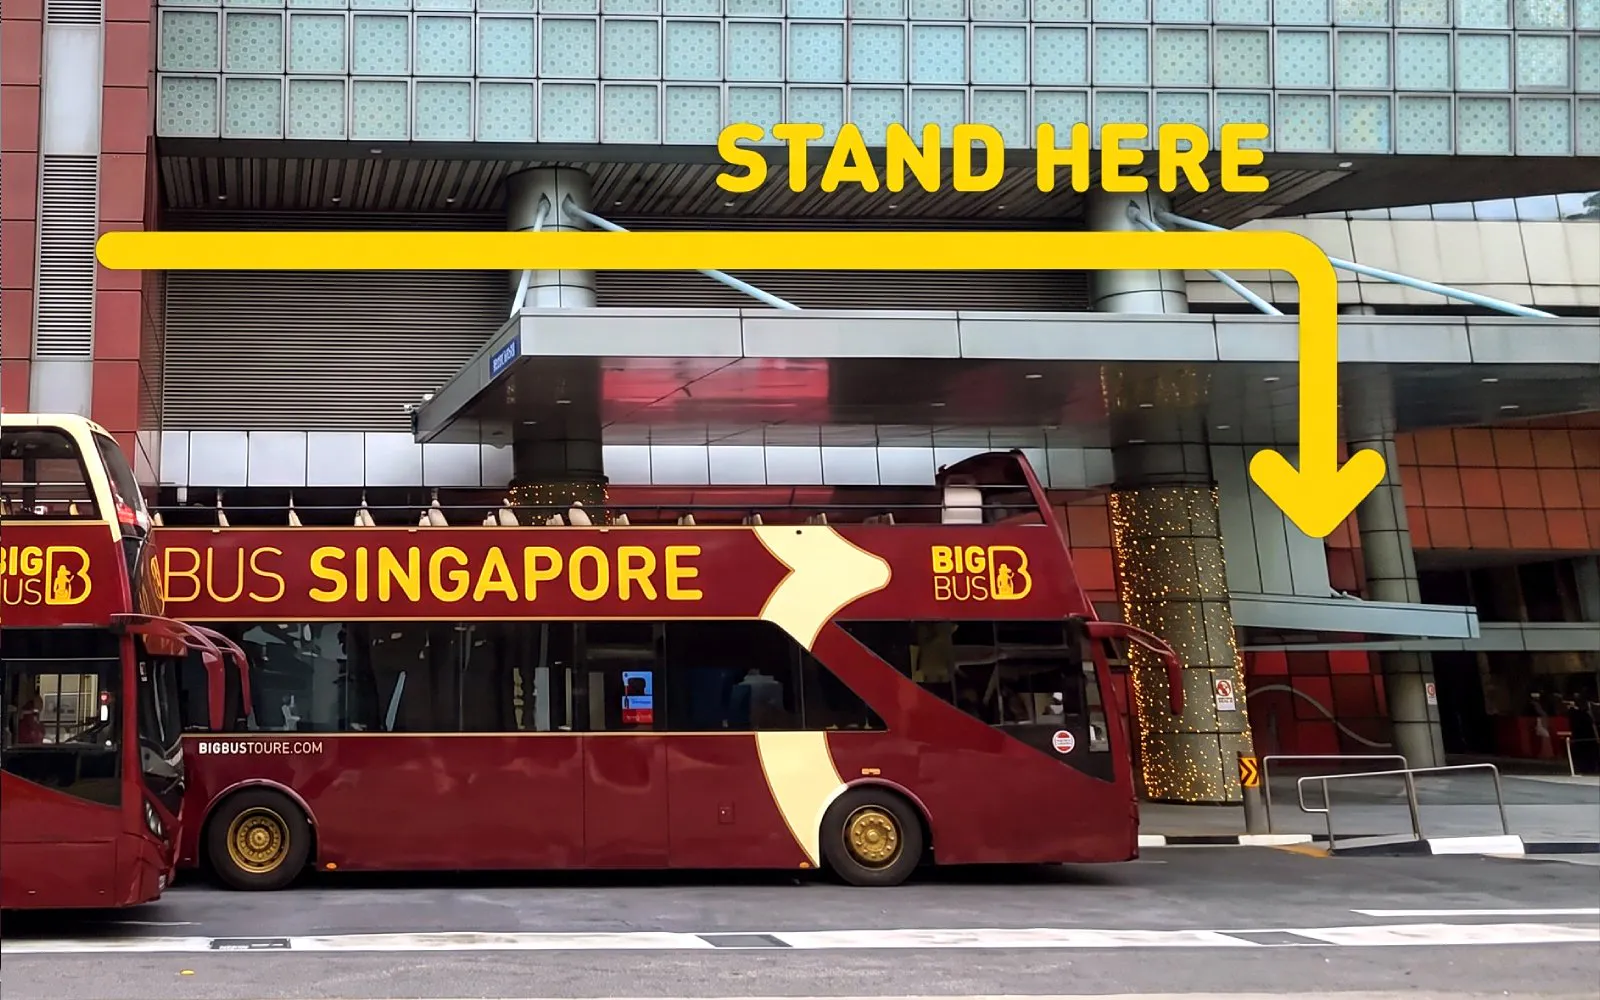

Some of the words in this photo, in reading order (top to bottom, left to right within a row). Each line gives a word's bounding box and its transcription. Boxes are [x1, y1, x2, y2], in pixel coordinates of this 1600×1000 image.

[1, 546, 43, 576] IG
[931, 545, 986, 574] BIG
[165, 547, 285, 603] BUS
[308, 546, 703, 603] SINGAPORE
[934, 575, 988, 601] BUS
[1, 578, 42, 605] US
[199, 741, 323, 755] BIGBUSTOURE.COM
